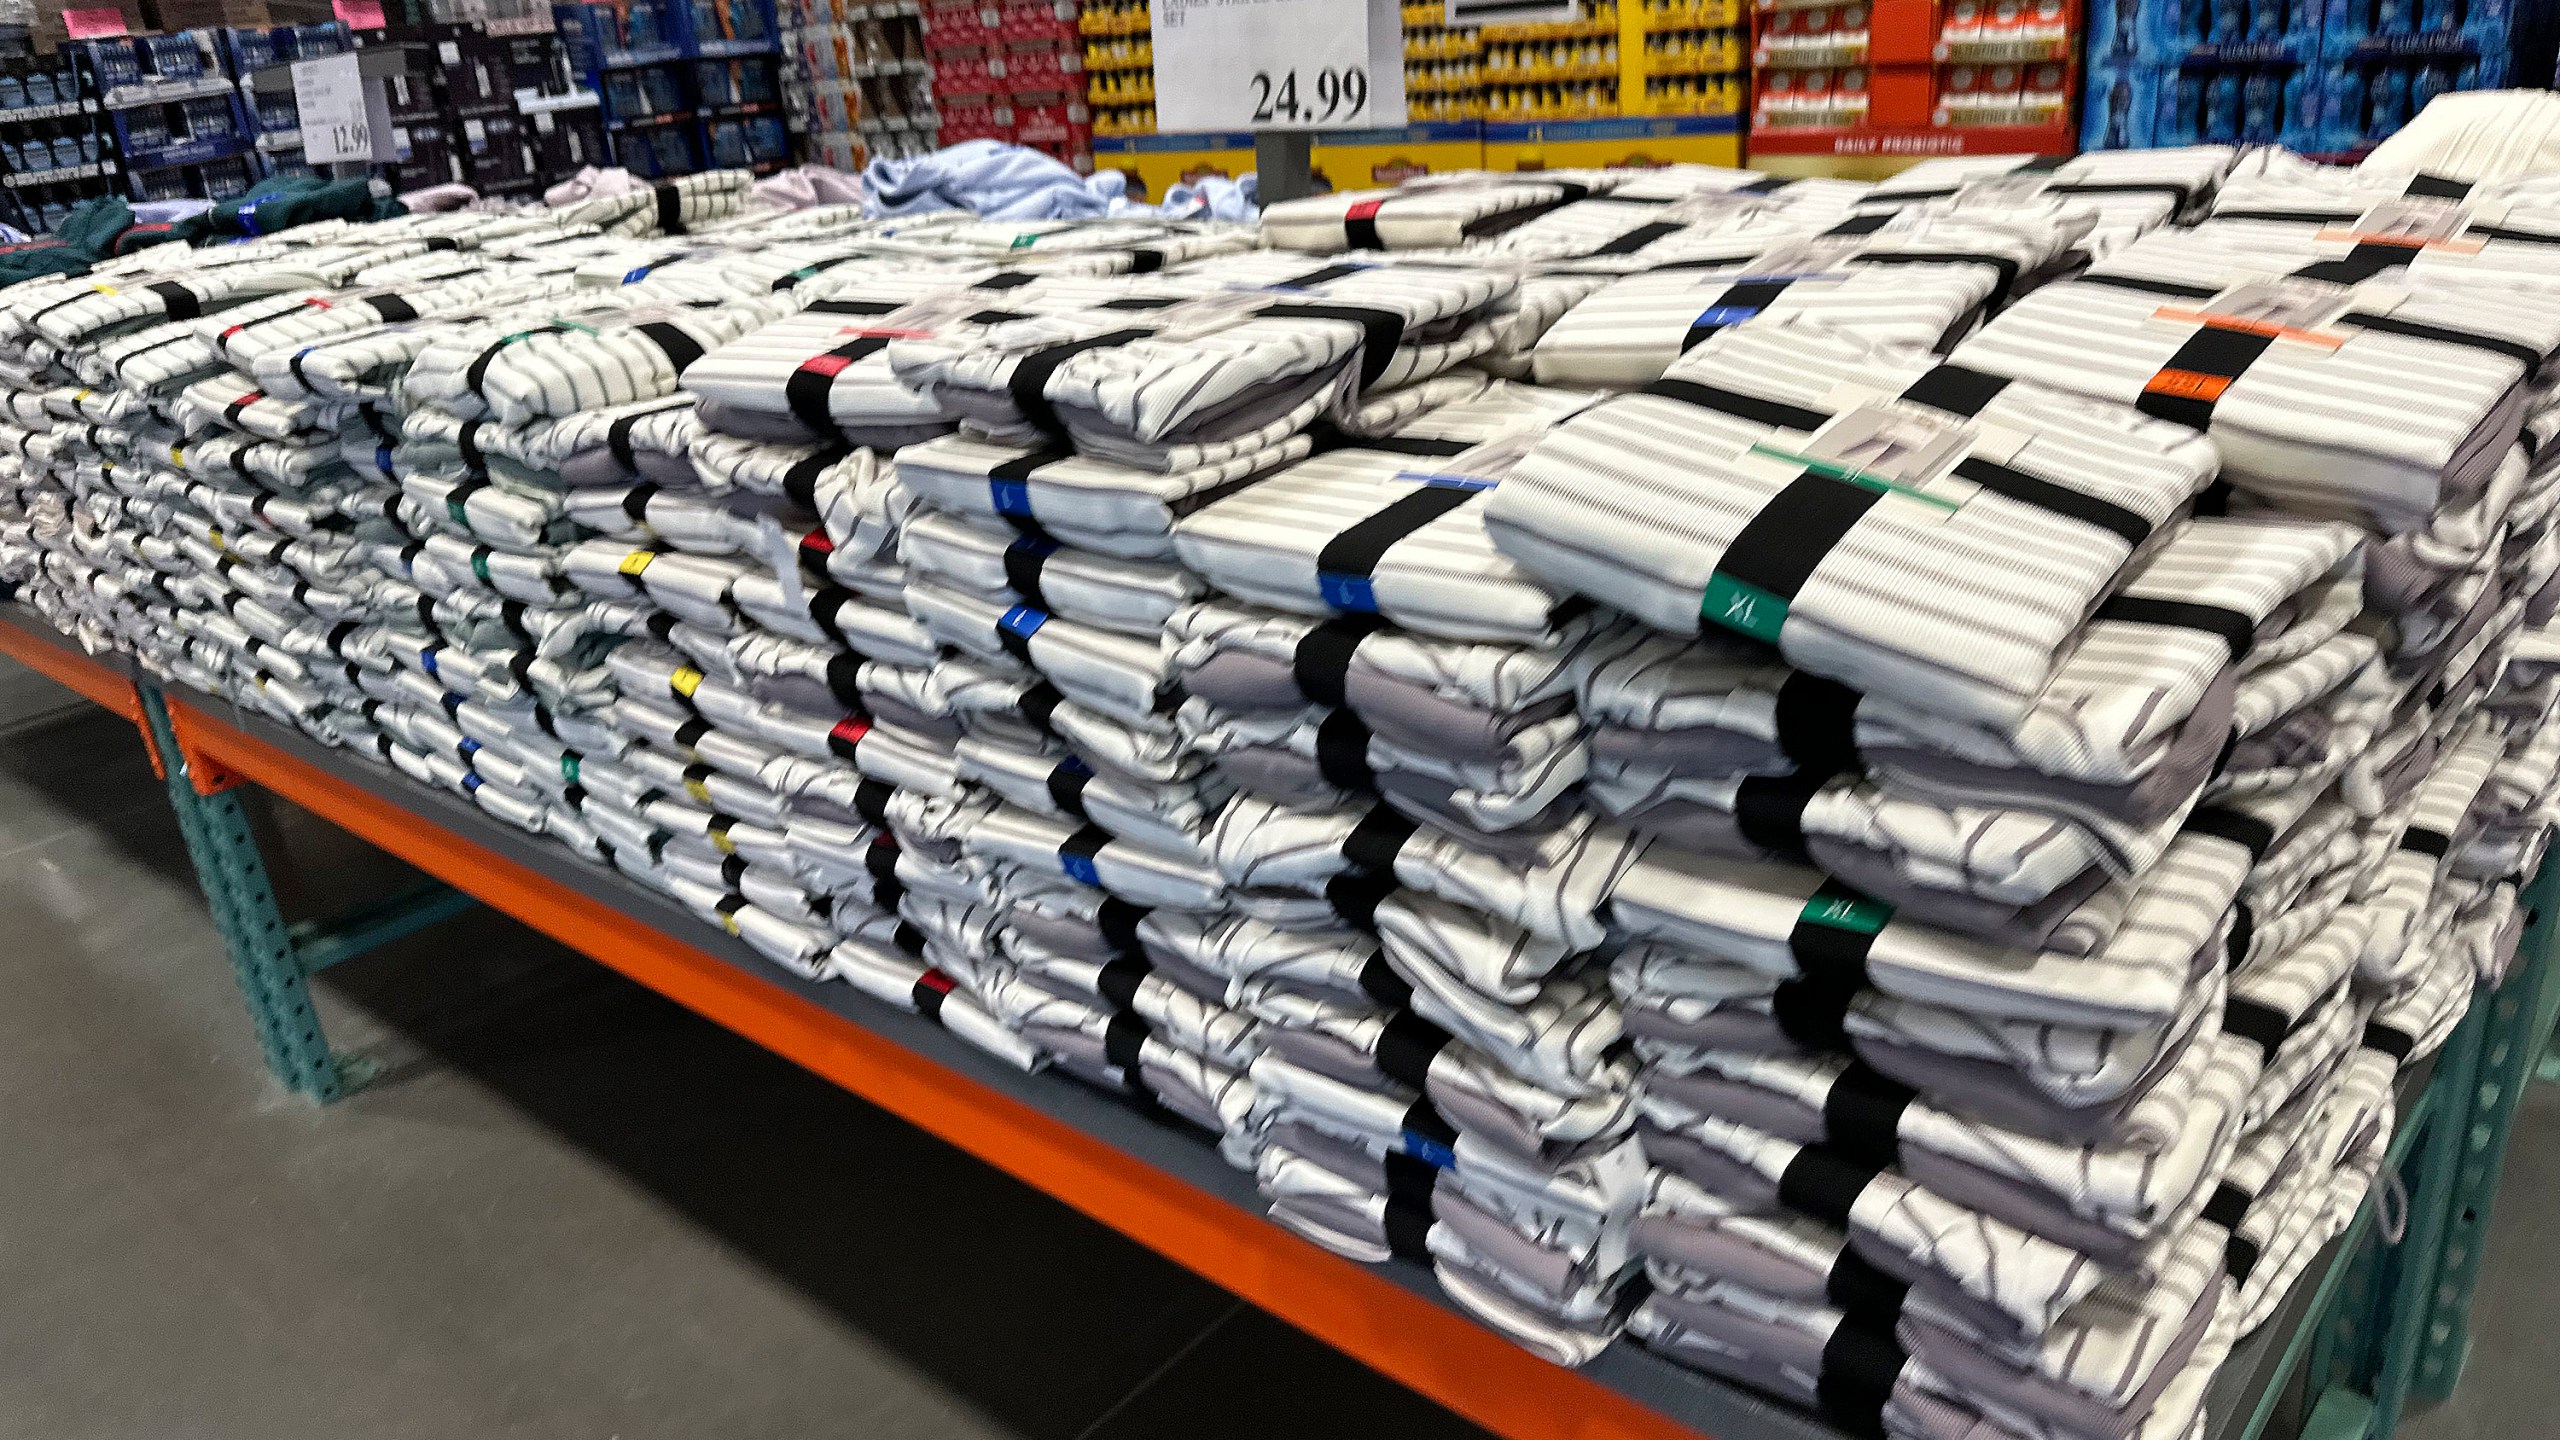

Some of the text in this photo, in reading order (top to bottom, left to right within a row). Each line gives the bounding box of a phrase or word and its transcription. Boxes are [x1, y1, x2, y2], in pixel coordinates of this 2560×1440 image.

[1250, 66, 1368, 124] 24.99
[333, 122, 368, 154] 12.99
[1834, 135, 1964, 153] DAILY PROBIOTIC
[1723, 589, 1759, 629] XL
[1821, 899, 1856, 922] XL
